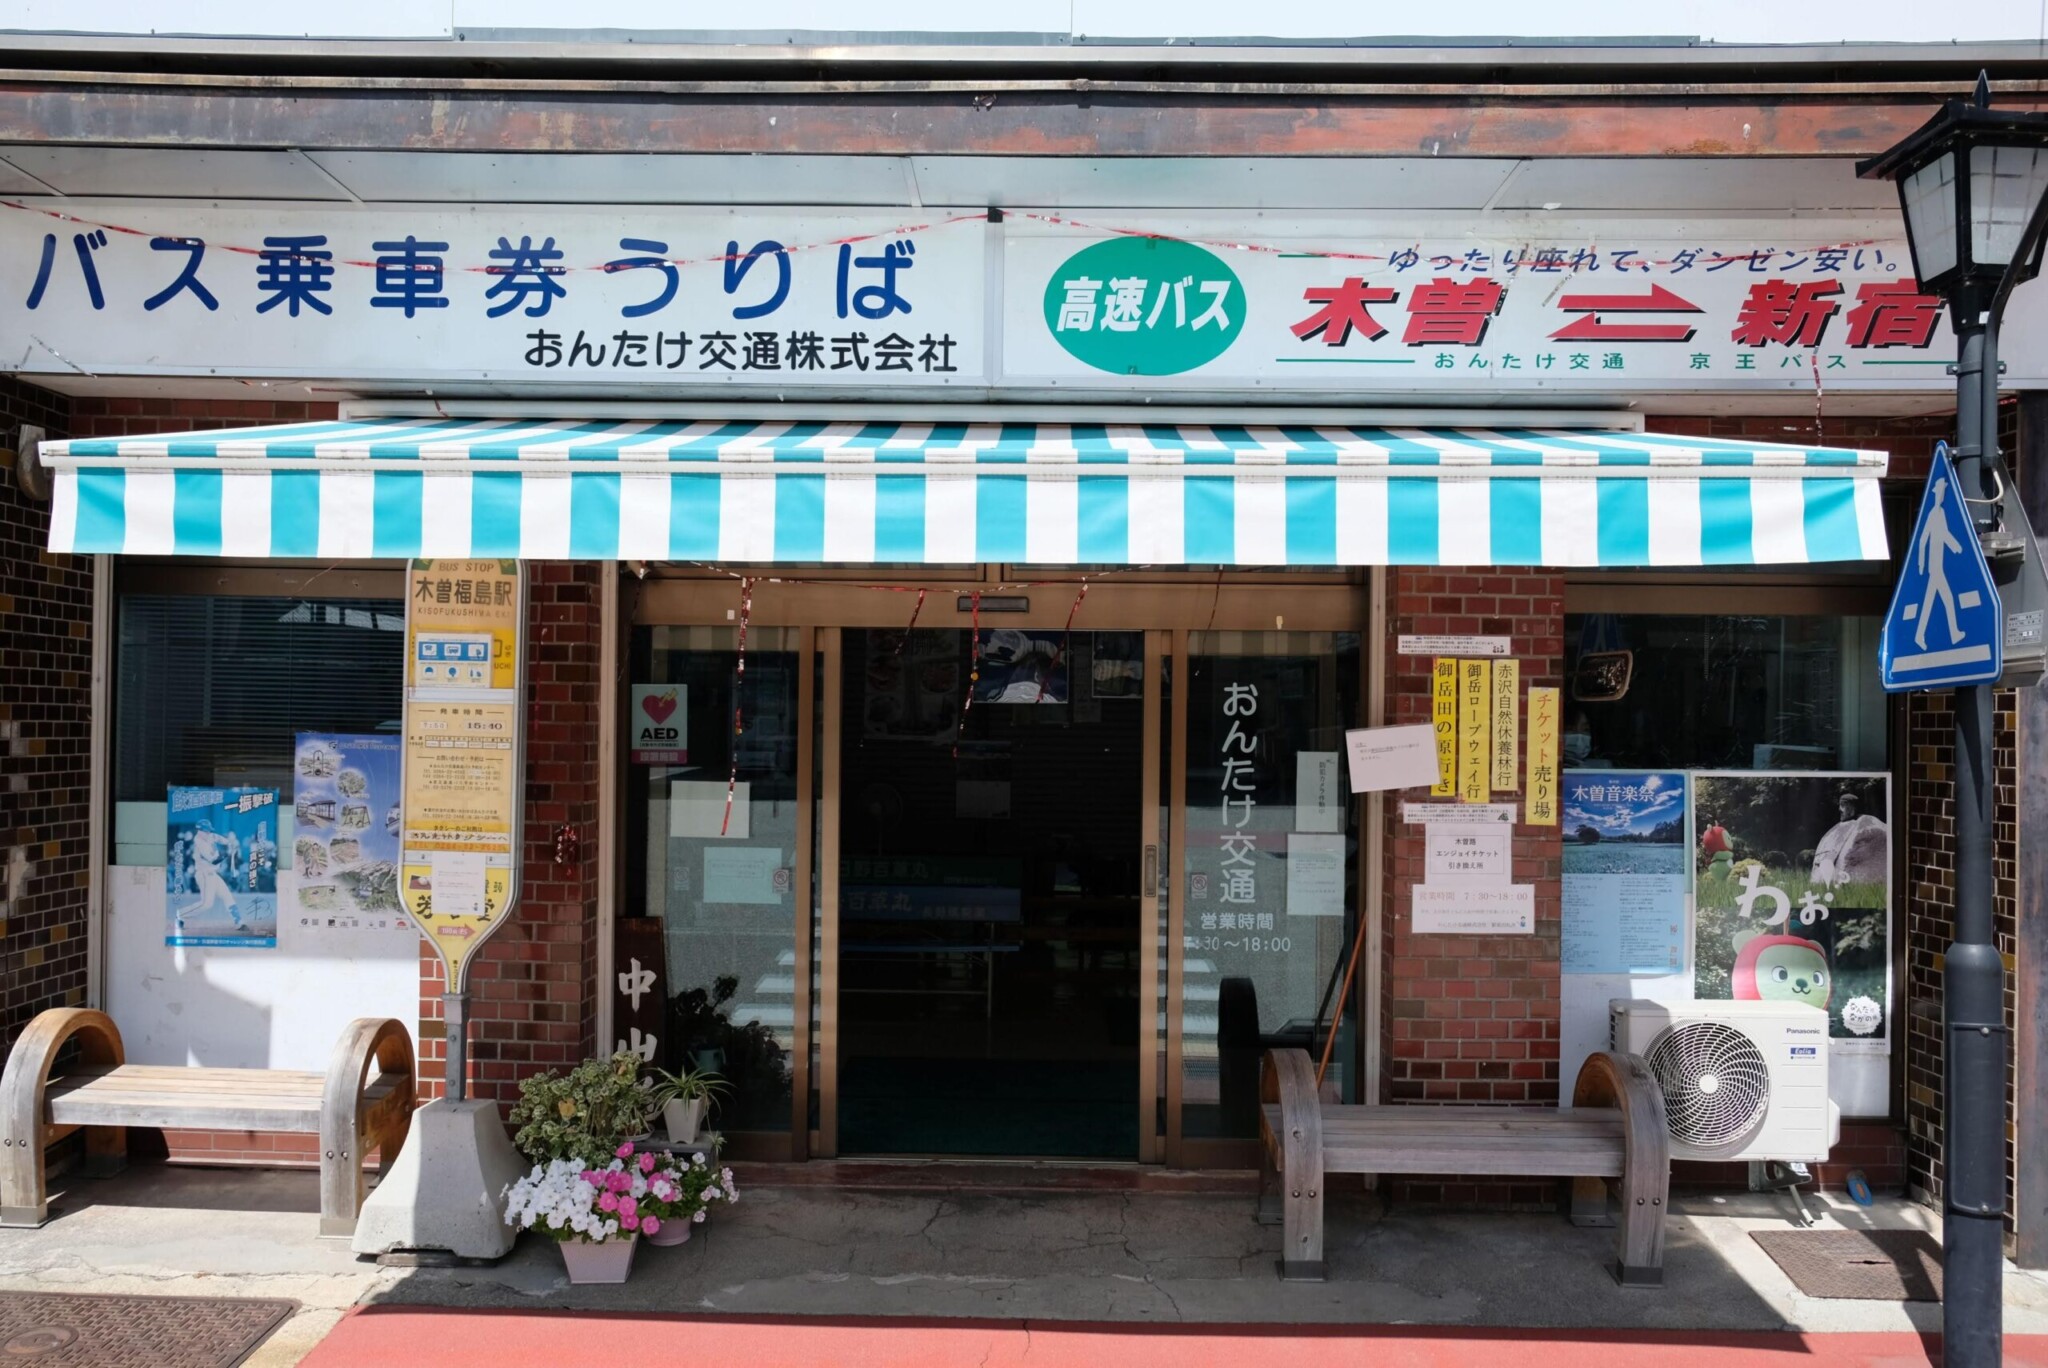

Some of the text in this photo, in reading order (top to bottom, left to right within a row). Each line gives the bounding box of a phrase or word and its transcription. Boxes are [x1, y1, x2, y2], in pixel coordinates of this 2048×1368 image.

[26, 229, 916, 319] バス乗車券うりば
[1056, 275, 1232, 332] 高速バス
[1289, 277, 1948, 348] 木曽 新宿
[524, 328, 958, 373] おんたけ交通株式会社
[1434, 351, 1847, 371] おんたけ交通 京王バス
[438, 562, 494, 573] BUS STOP
[415, 576, 513, 607] 木曽福島駅
[417, 606, 491, 617] KISOFUKUSHIMA
[467, 722, 503, 730] 15:40
[640, 727, 679, 740] AED
[1466, 664, 1483, 799] 御岳ロープウェイ行
[1497, 664, 1513, 786] 赤沢自然休養林行
[1534, 694, 1552, 819] チケット売り場
[1220, 682, 1258, 904] おんたけ交通
[1571, 784, 1656, 803] 木曽音楽祭
[1436, 850, 1499, 858] エンジョイチケット
[1200, 912, 1274, 930] 営業時間
[1786, 1027, 1821, 1035] Panasonic
